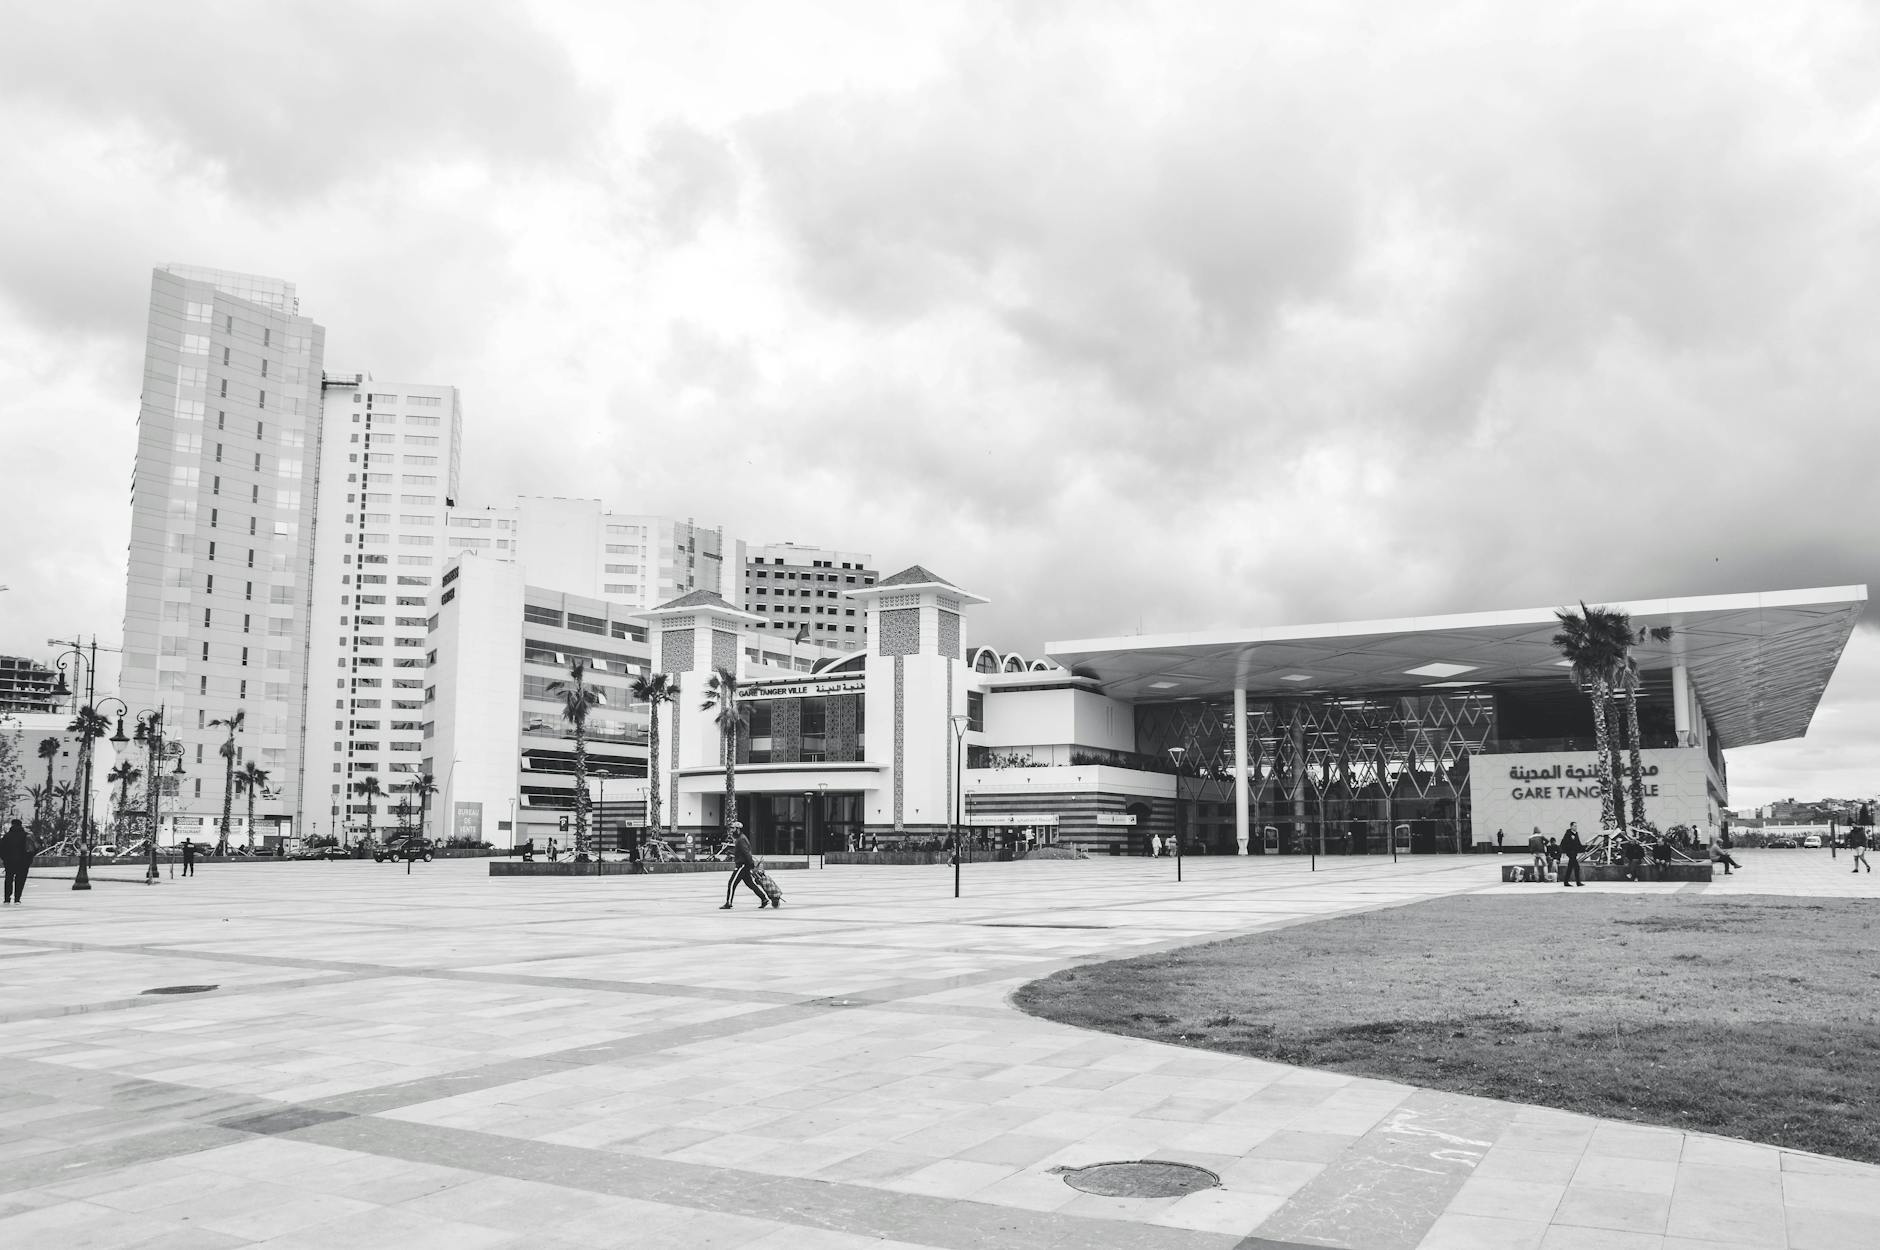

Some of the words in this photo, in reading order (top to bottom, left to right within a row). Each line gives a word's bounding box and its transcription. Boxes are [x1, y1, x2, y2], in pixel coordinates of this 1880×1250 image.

[739, 689, 758, 697] GARE
[760, 688, 787, 696] TANGER
[788, 685, 807, 694] VILLE
[1510, 764, 1561, 783] المدينة
[1511, 786, 1552, 800] GARE
[1557, 785, 1605, 799] TANG
[1621, 784, 1659, 797] VLE
[457, 808, 480, 816] BUREAU
[459, 825, 477, 833] VENTE
